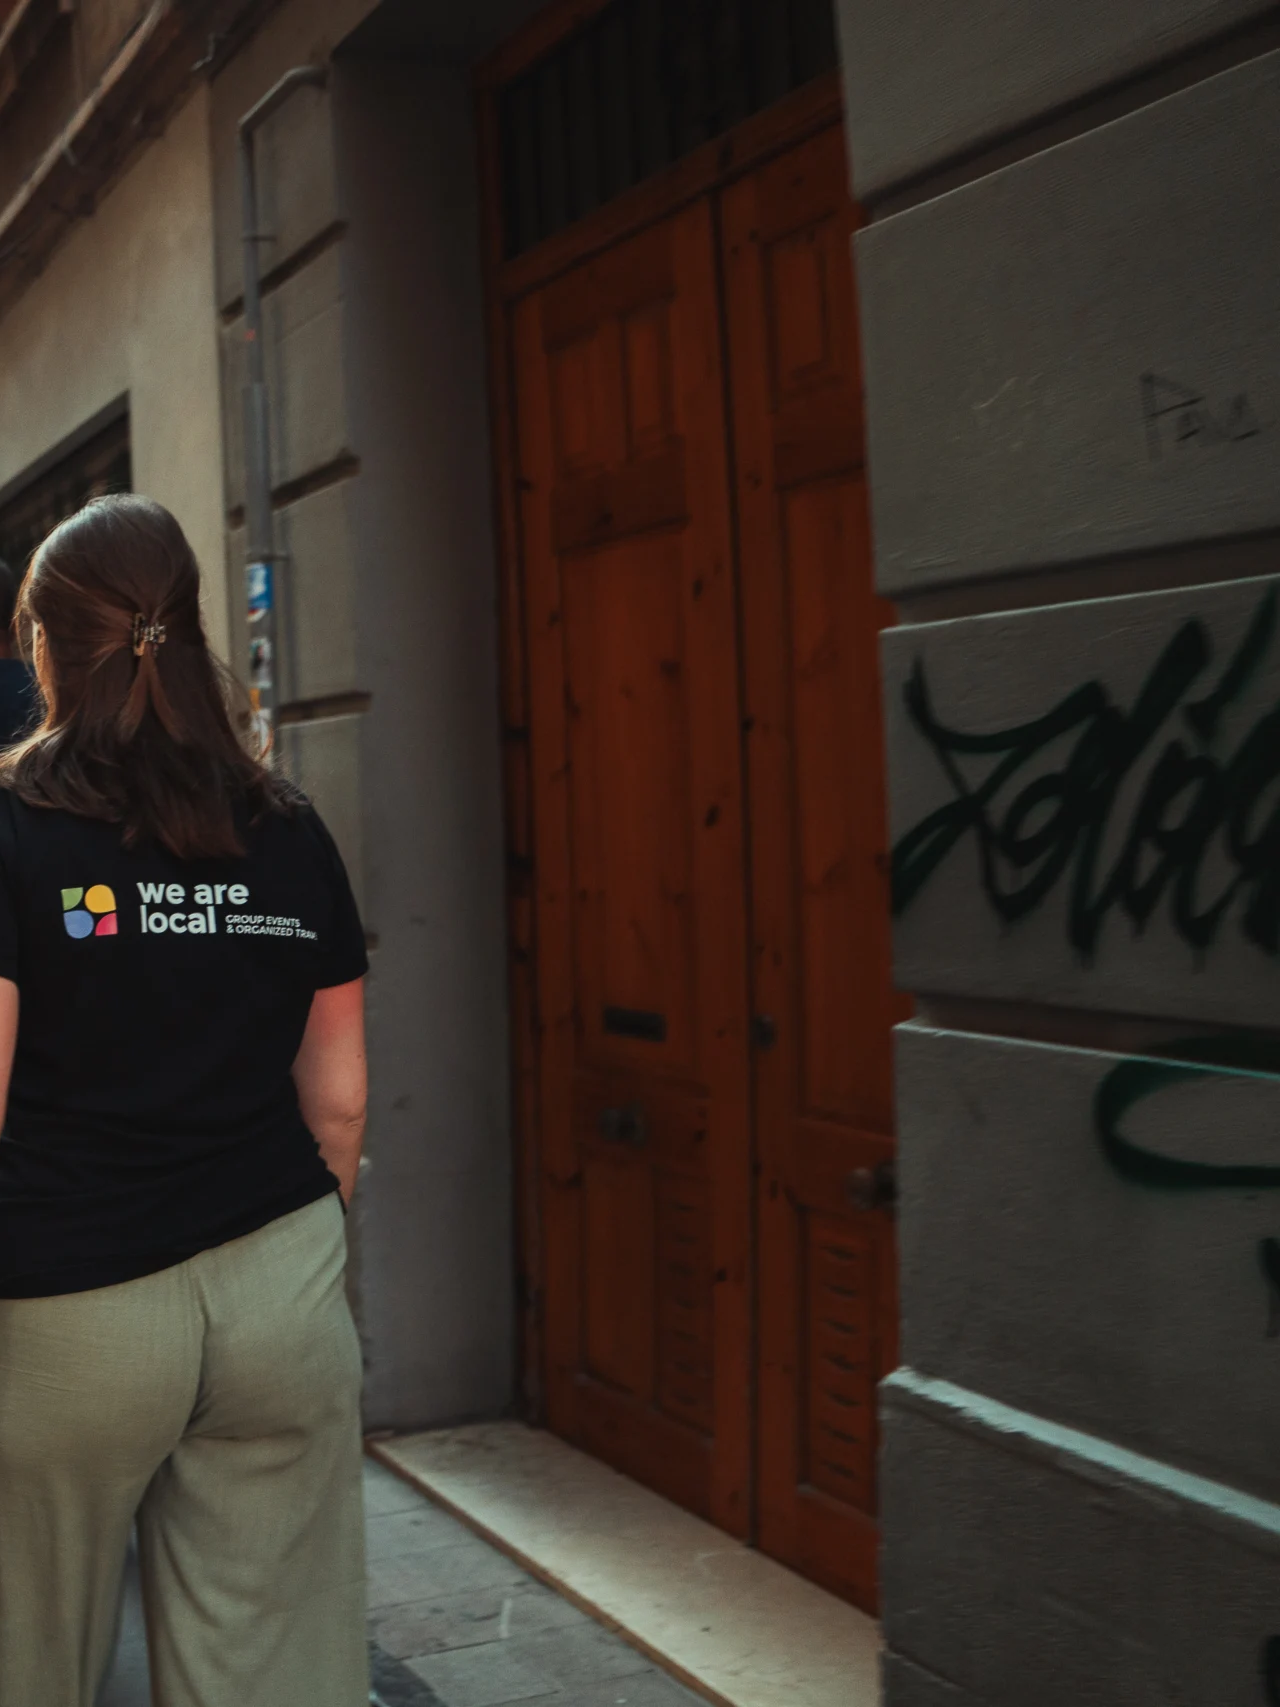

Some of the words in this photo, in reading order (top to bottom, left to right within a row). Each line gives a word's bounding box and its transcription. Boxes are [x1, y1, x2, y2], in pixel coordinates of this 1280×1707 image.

[136, 882, 186, 905] we
[194, 883, 250, 905] are
[140, 904, 217, 934] local
[225, 914, 265, 924] GROUP
[265, 915, 301, 927] EVENTS
[226, 924, 235, 934] &
[235, 924, 294, 937] ORGANIZED
